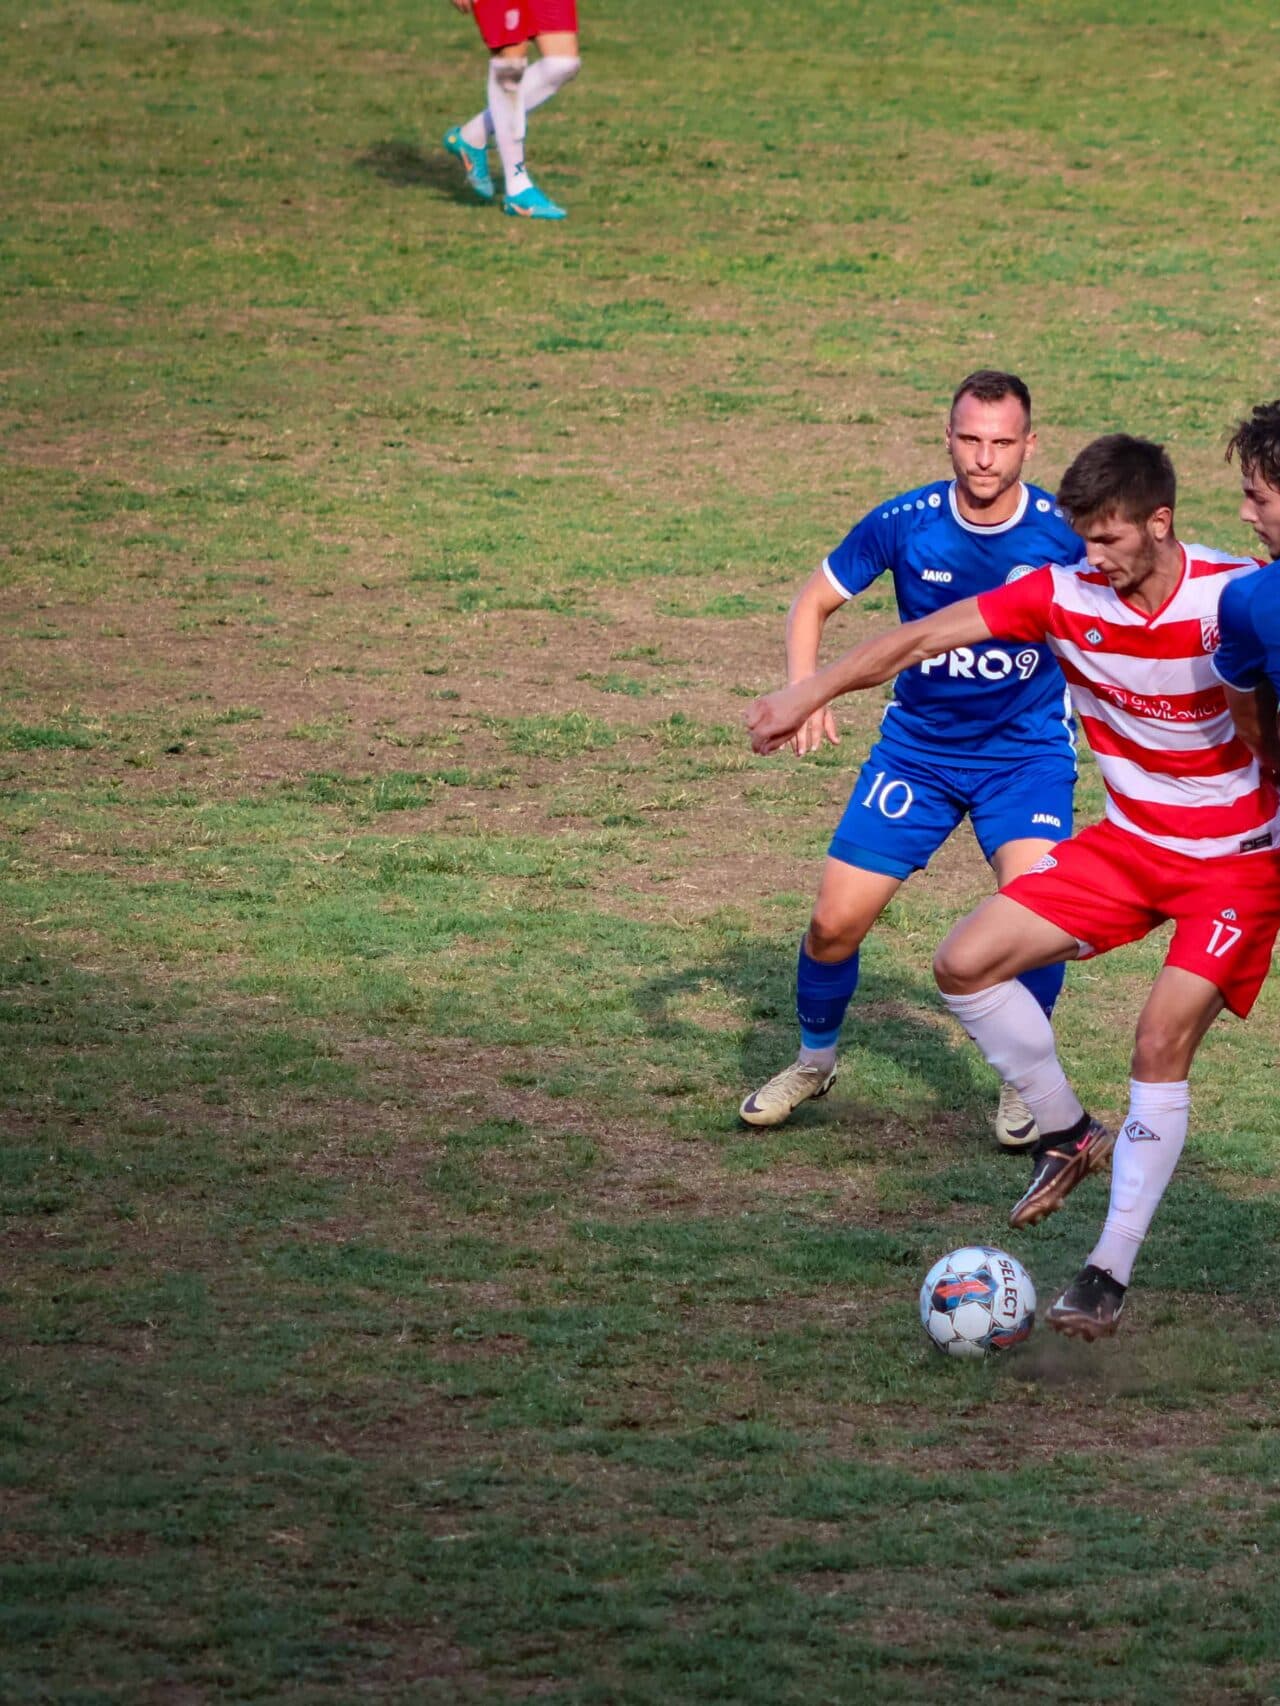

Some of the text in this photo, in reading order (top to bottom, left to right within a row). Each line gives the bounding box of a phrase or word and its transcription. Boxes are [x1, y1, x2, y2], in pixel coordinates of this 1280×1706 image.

[921, 569, 952, 583] JAKO
[921, 647, 1040, 680] PRO9
[861, 771, 913, 819] 10
[1031, 813, 1061, 828] JAKO
[1206, 919, 1242, 958] 17
[998, 1259, 1018, 1319] SELECT
